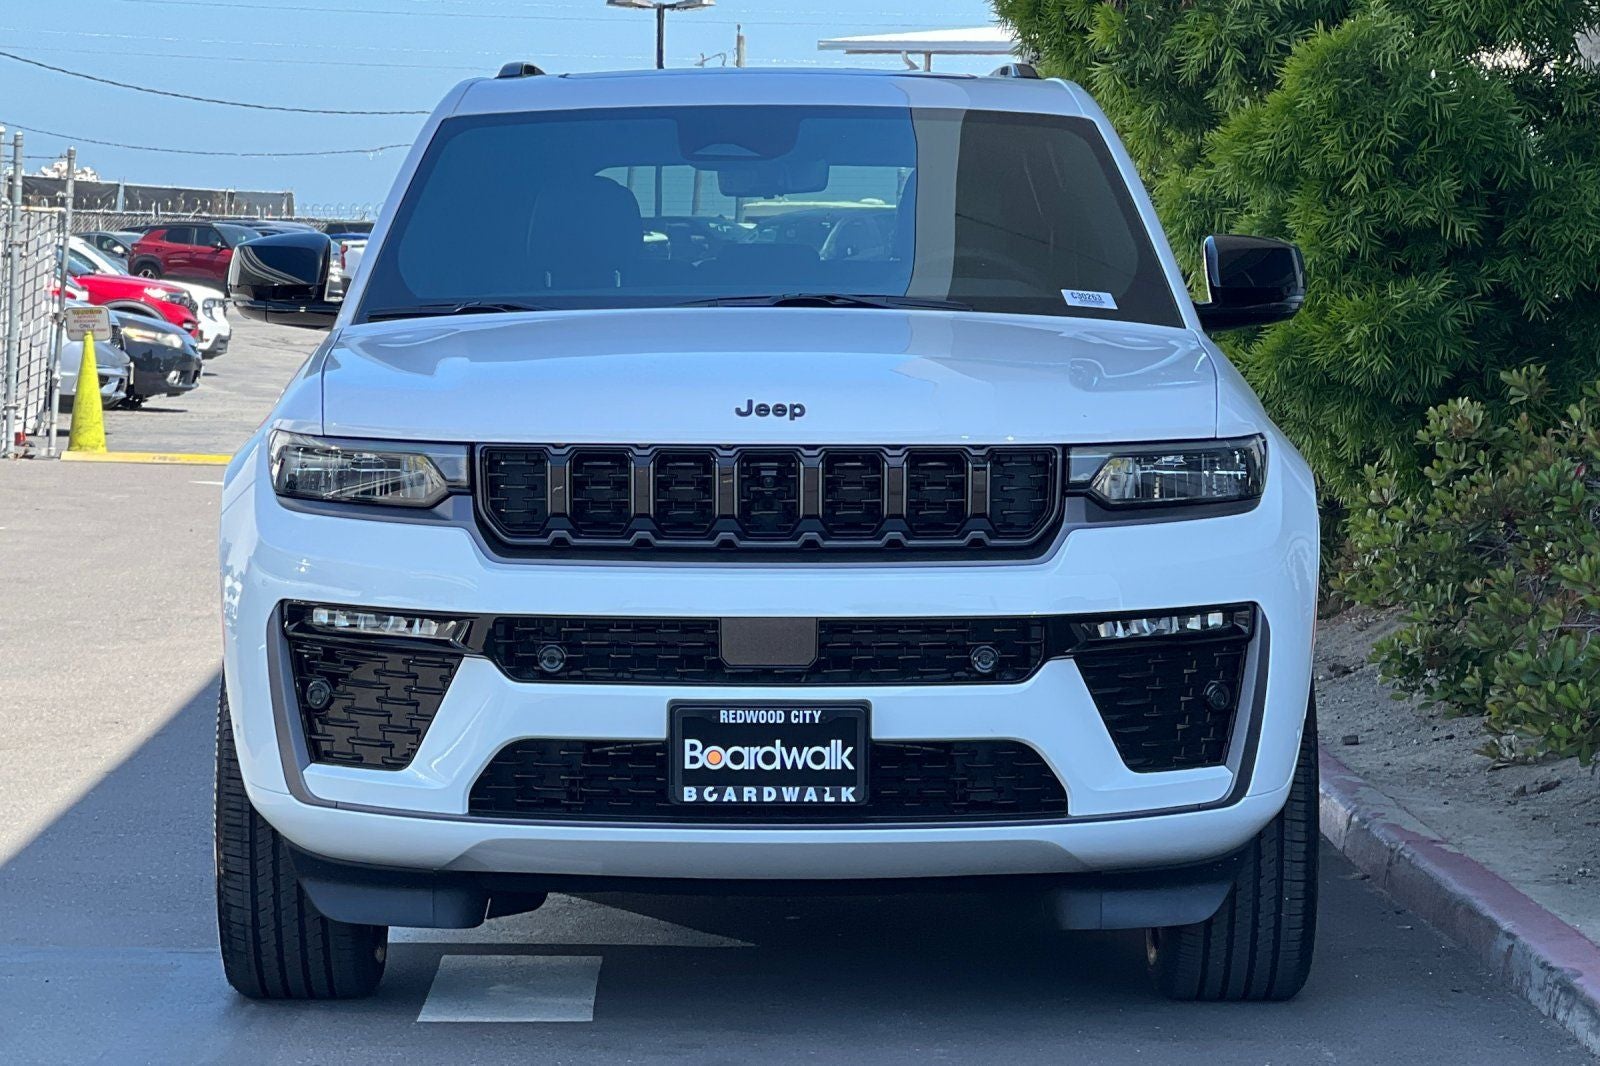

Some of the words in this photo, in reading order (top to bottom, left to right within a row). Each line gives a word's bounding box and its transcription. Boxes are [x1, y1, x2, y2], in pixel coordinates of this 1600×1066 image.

[735, 399, 806, 421] Jeep
[719, 710, 785, 724] REDWOOD
[790, 710, 822, 724] CITY
[684, 738, 855, 771] Boardwalk
[683, 786, 856, 803] BOARDWALK
